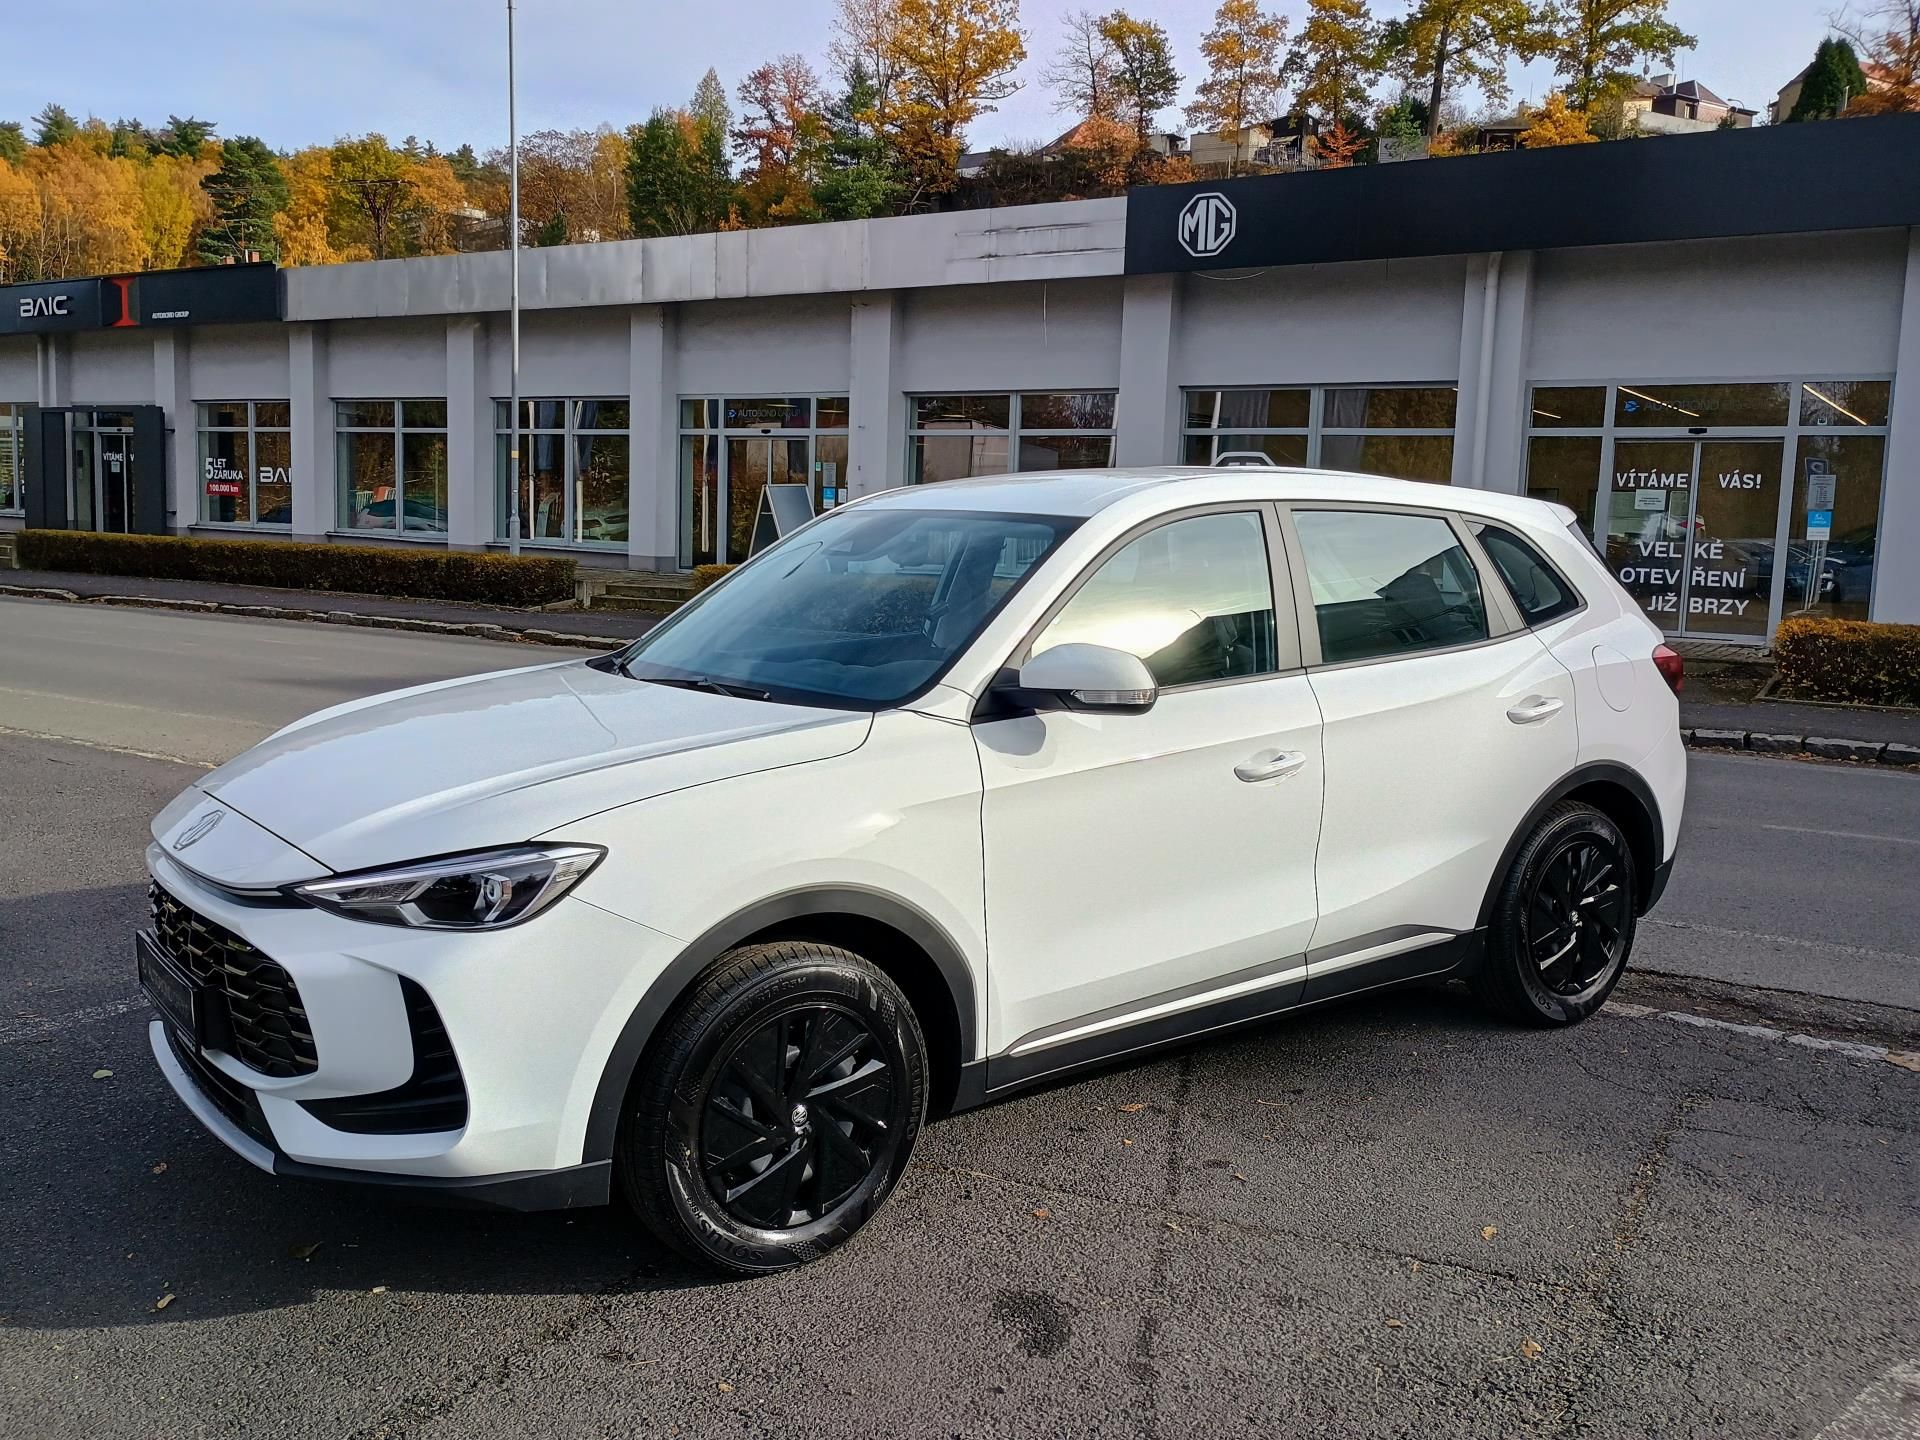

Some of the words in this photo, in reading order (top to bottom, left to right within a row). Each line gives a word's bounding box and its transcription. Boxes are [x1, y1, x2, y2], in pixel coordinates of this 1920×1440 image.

[1183, 198, 1231, 251] MG
[20, 296, 67, 317] BAIC
[213, 458, 226, 468] LET
[213, 467, 244, 480] ZÁRUKA
[260, 466, 292, 483] BAI
[1616, 469, 1689, 488] VÍTÁME
[1719, 469, 1762, 489] VÁS!
[1647, 592, 1678, 612] JIŽ
[1689, 596, 1750, 616] BRZY
